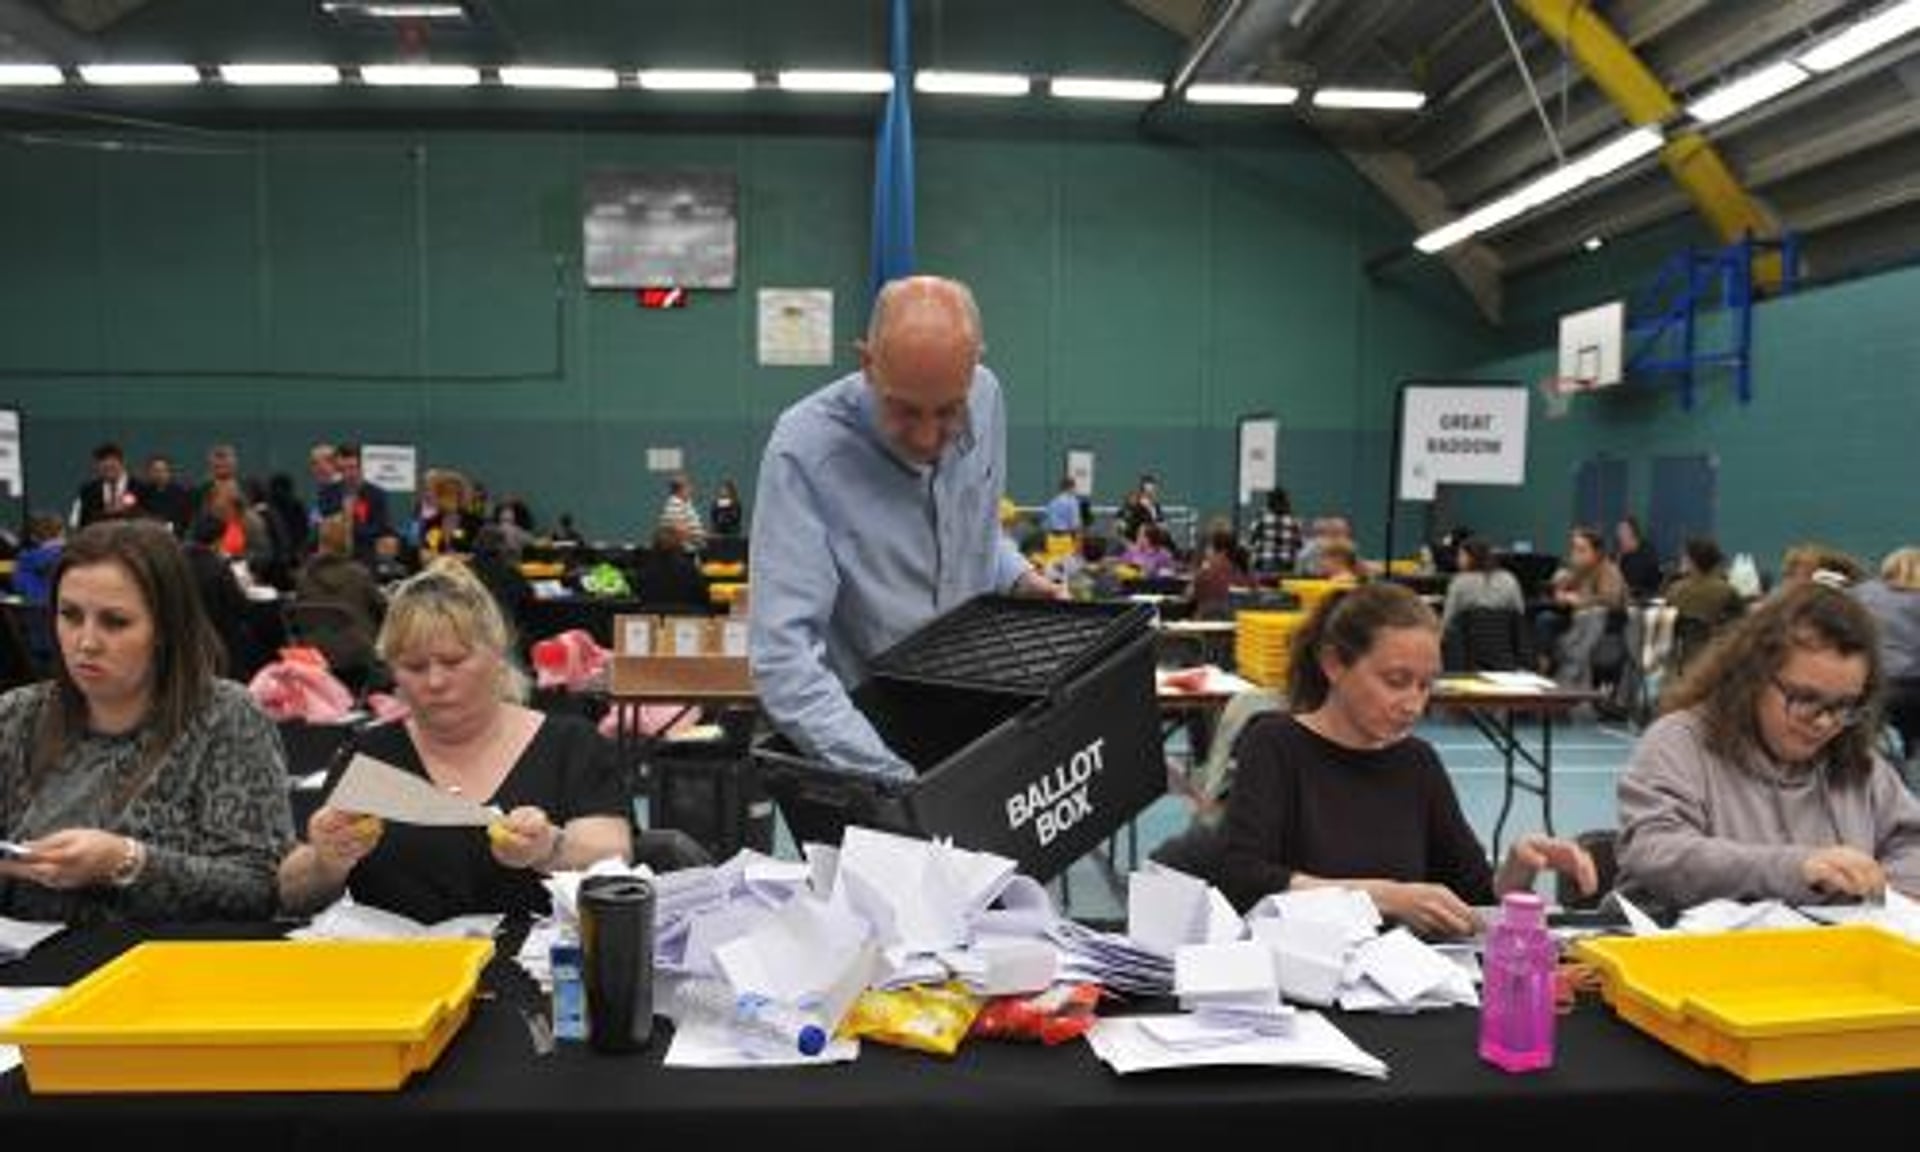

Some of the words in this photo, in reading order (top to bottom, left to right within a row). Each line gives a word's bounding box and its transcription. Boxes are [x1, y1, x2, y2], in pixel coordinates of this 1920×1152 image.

[1439, 413, 1492, 430] GREAT
[1007, 738, 1104, 828] BALLOT
[1036, 785, 1092, 846] BOX
